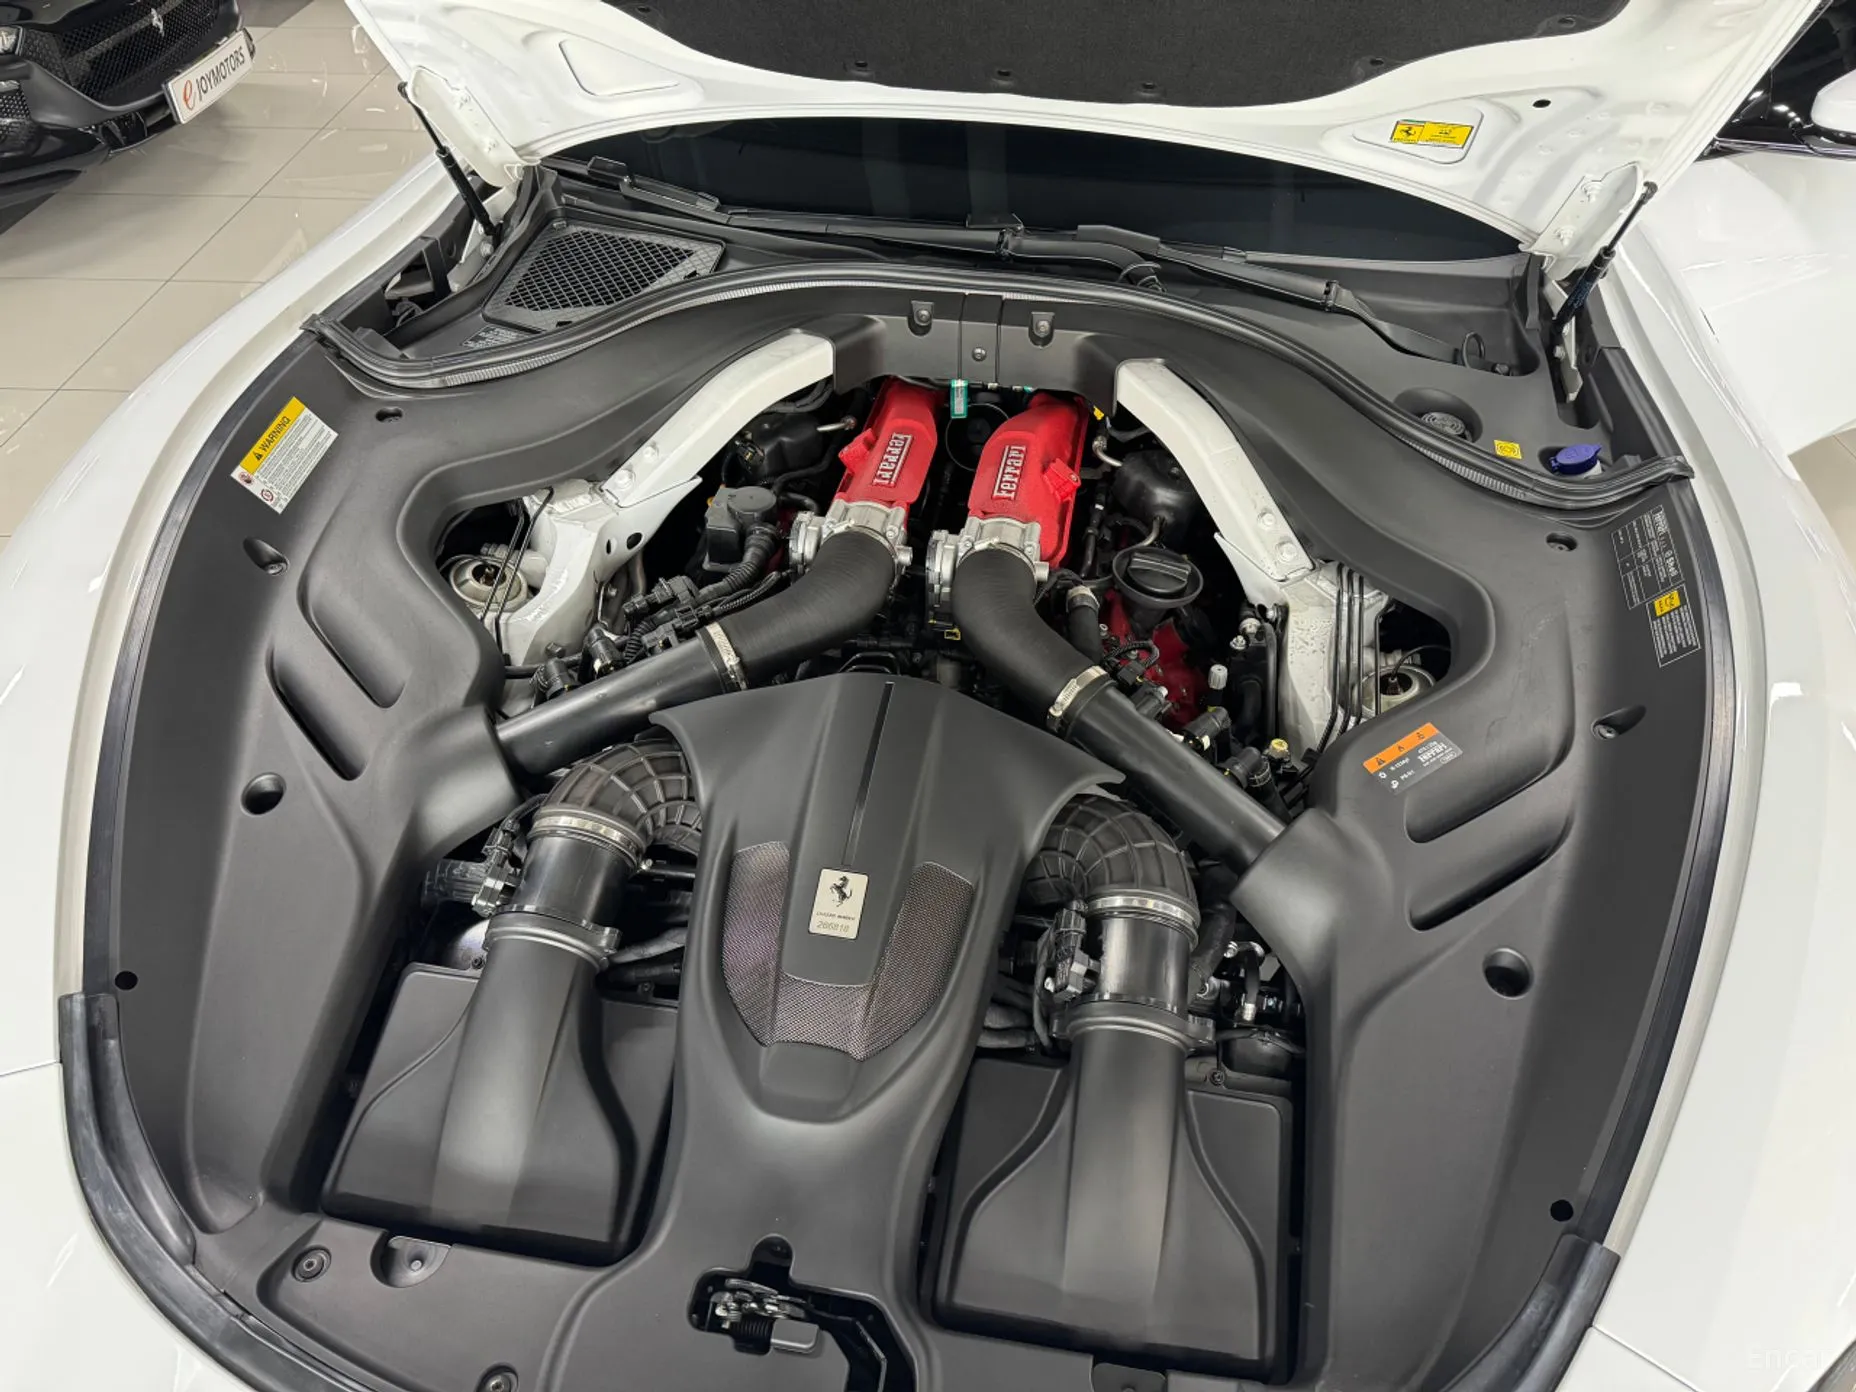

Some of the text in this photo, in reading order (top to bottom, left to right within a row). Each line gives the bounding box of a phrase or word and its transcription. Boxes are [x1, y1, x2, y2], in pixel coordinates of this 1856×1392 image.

[196, 45, 245, 102] JOYMOTORS
[260, 416, 291, 453] WARNING
[872, 432, 913, 487] Ferrari
[993, 445, 1027, 500] Ferrari
